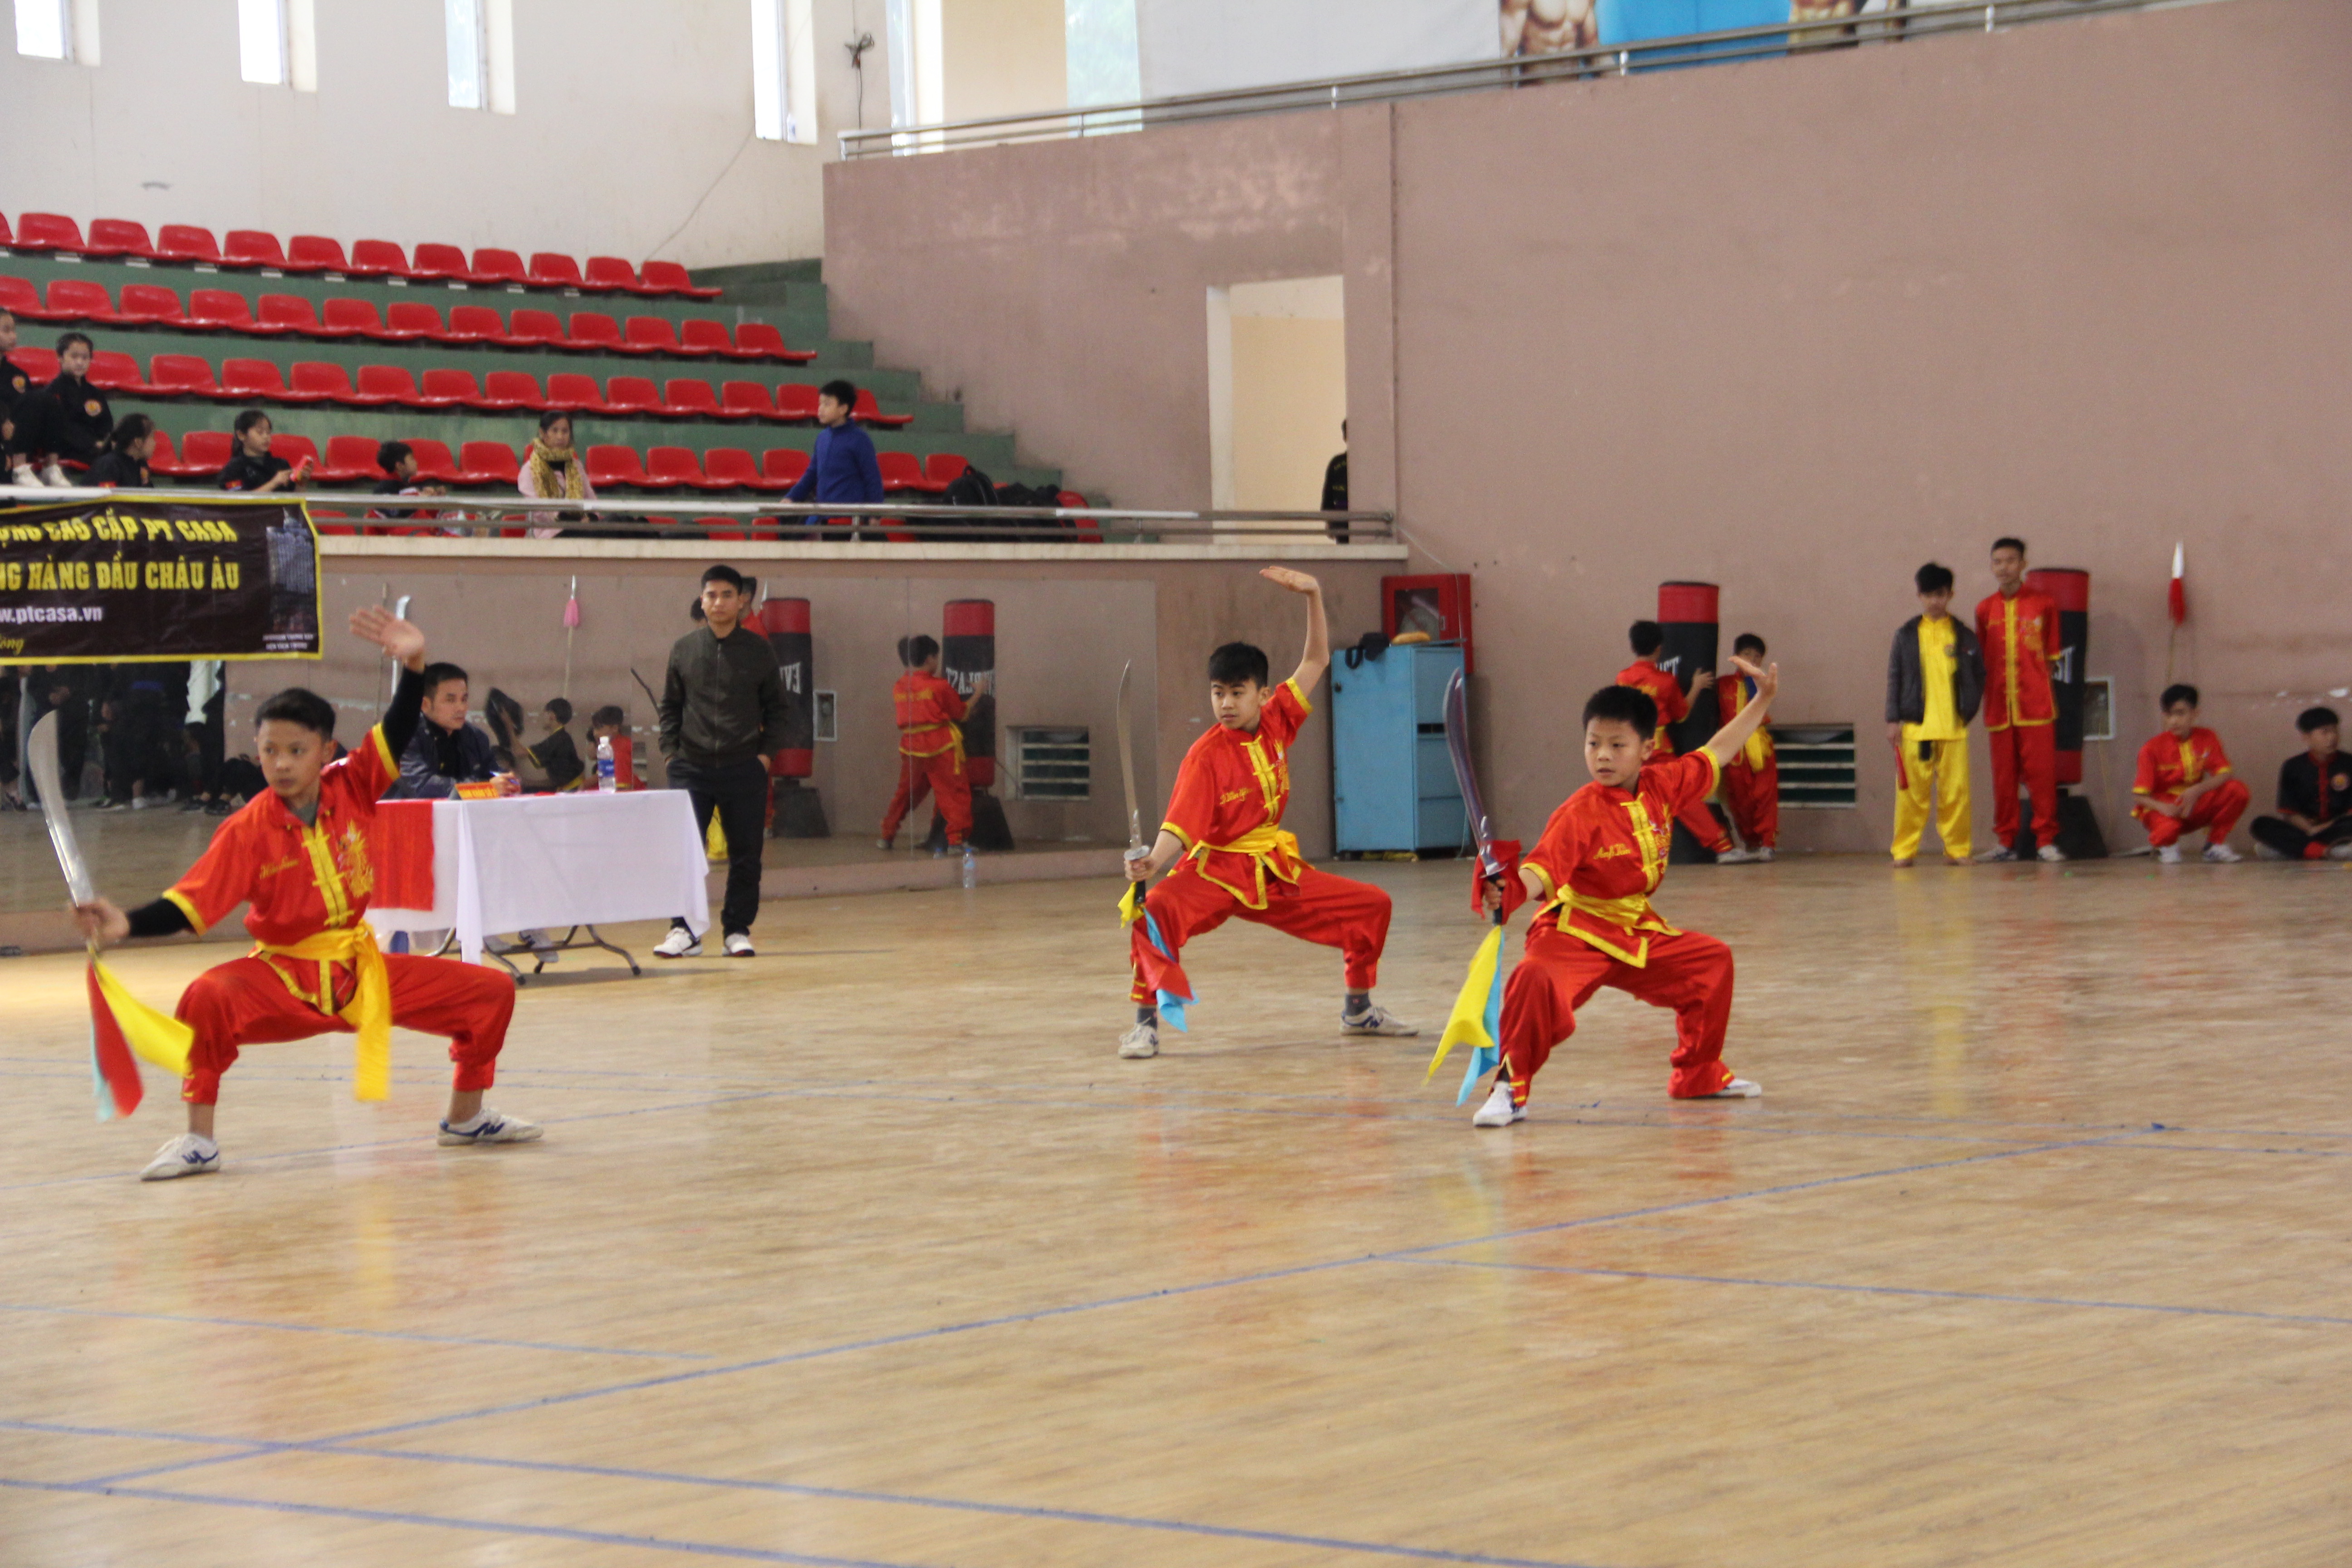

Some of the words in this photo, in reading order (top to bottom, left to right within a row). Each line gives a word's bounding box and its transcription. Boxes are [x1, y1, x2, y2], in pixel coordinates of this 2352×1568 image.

[42, 517, 90, 541] CAO
[140, 518, 174, 541] PT
[175, 520, 237, 542] CASA
[27, 554, 90, 590] HÀNG
[145, 554, 204, 590] CHÂU
[211, 555, 239, 590] ÂU
